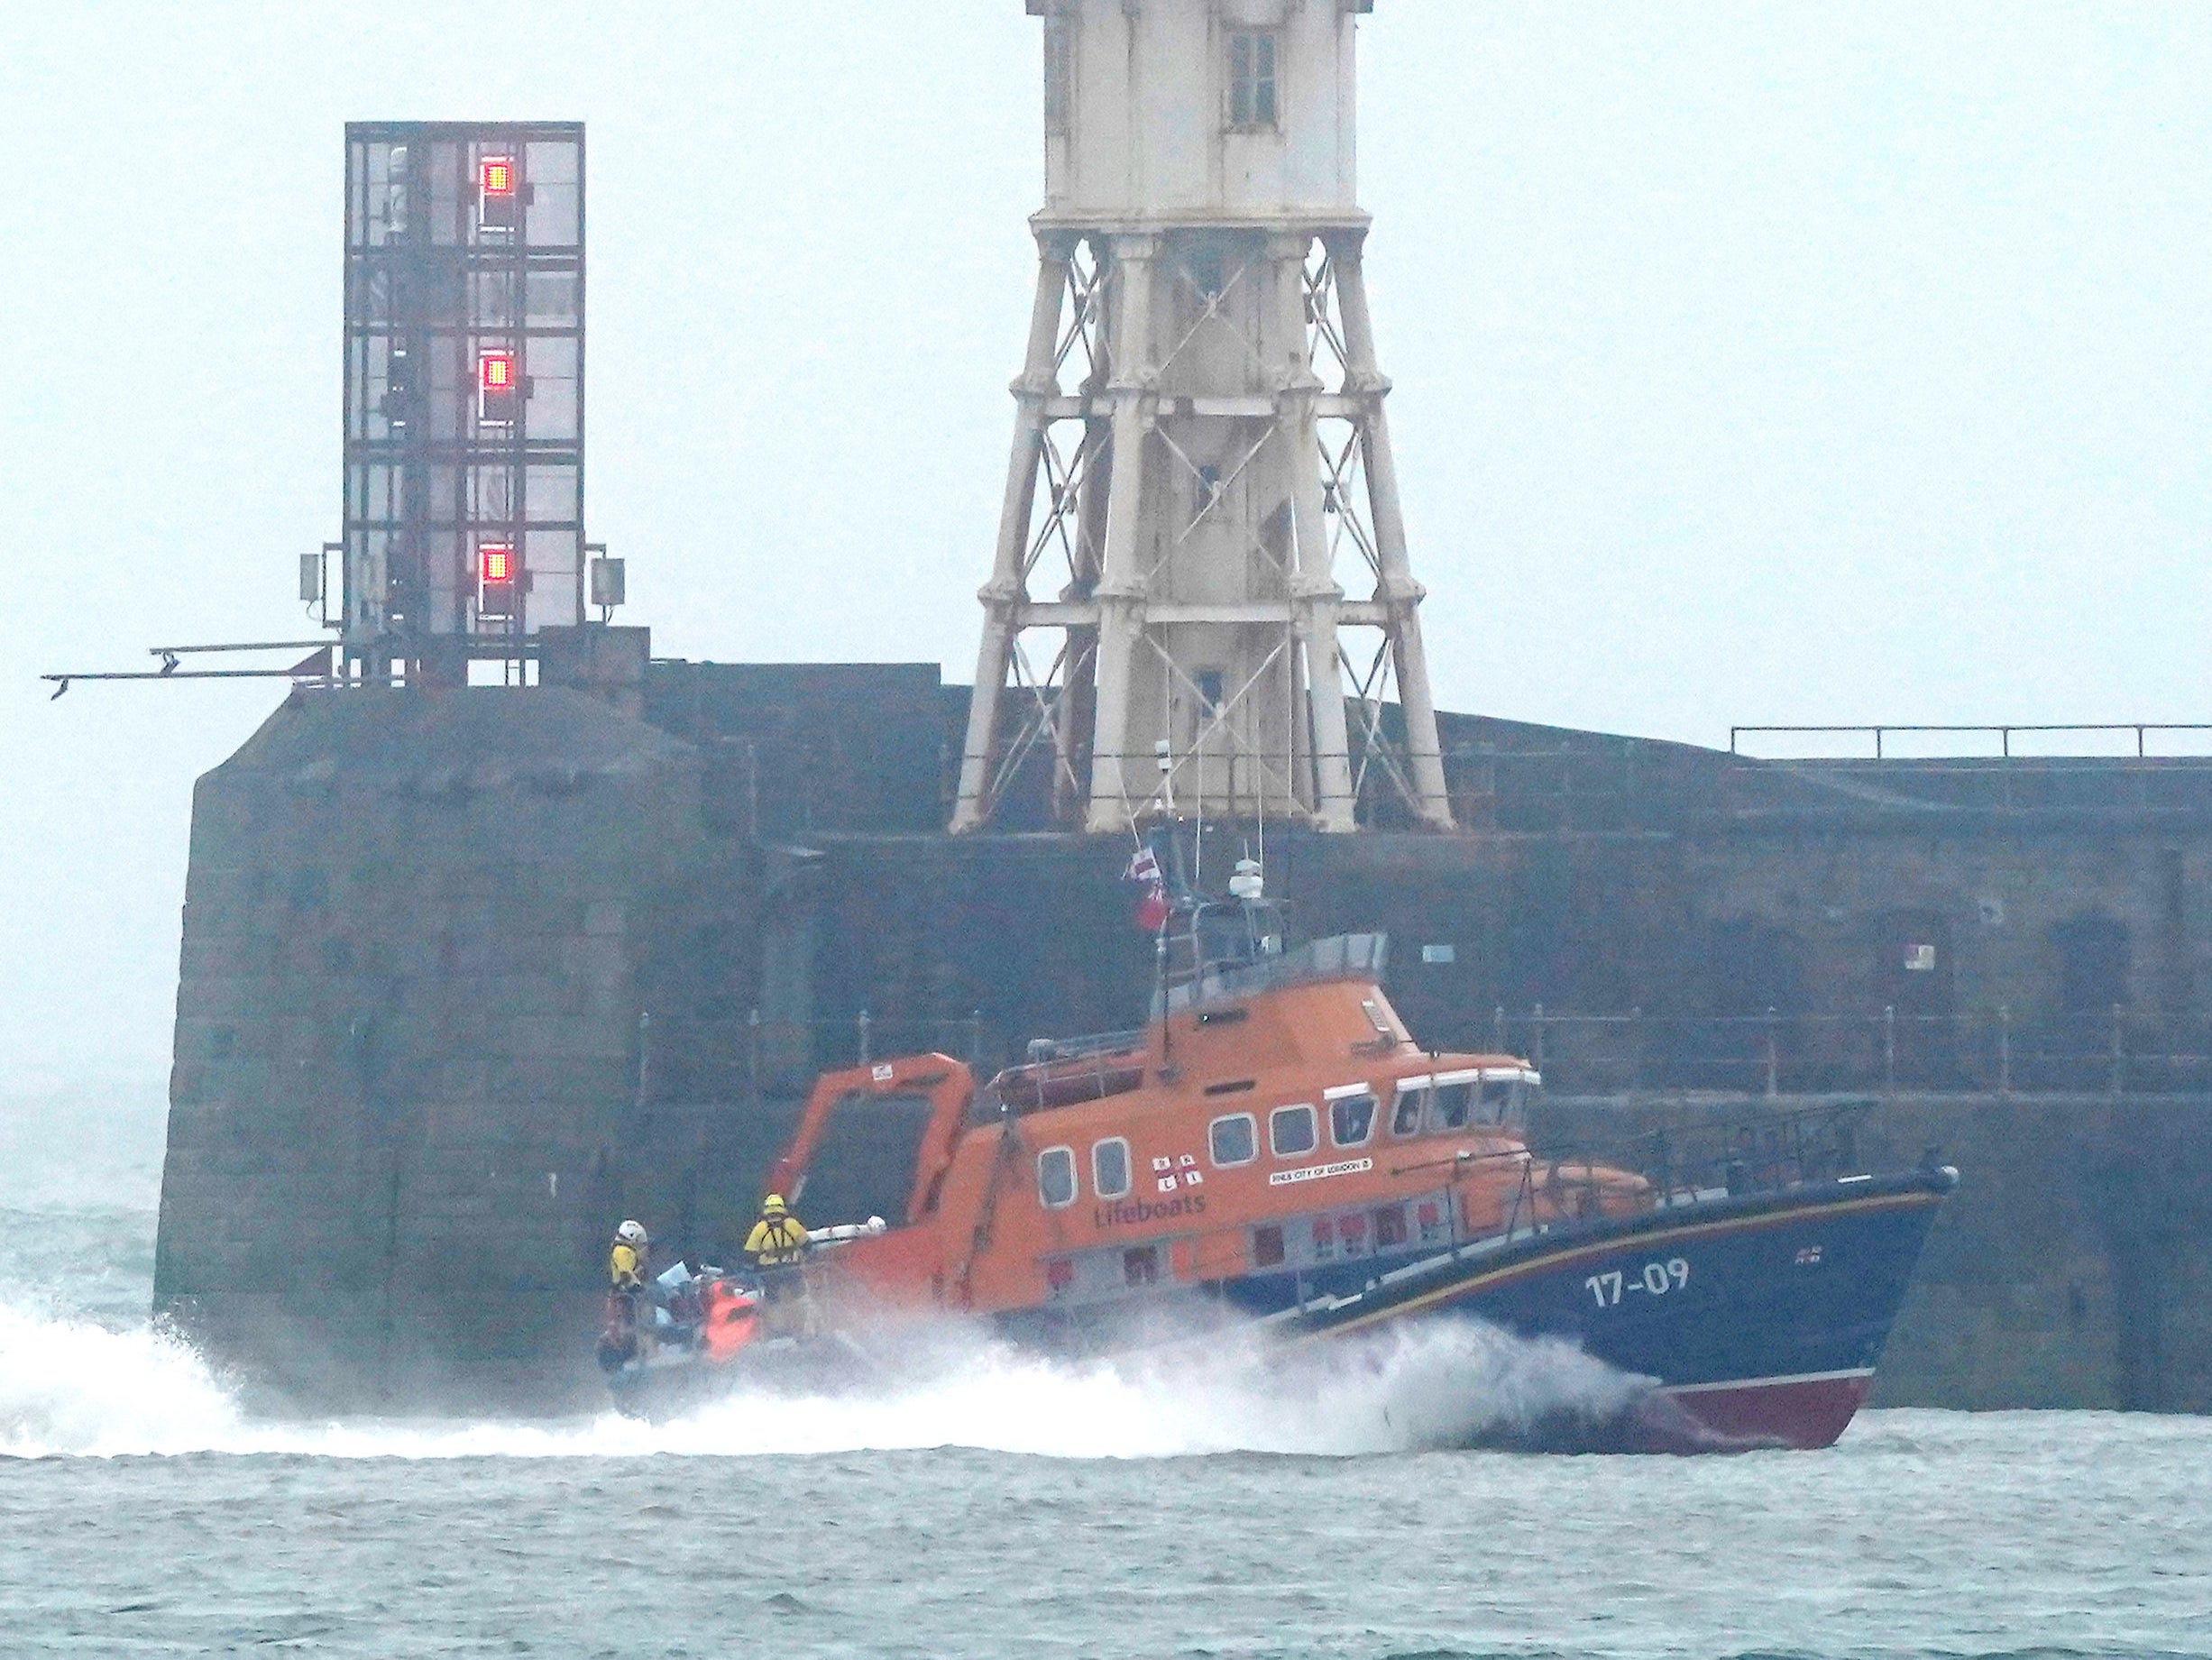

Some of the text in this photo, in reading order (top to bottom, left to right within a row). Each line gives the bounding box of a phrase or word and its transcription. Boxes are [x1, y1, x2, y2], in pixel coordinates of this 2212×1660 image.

[1315, 1167, 1325, 1176] OF
[1327, 1162, 1360, 1174] LONDON
[1095, 1194, 1206, 1229] Lifeboats
[1585, 1257, 1689, 1307] 17-09
